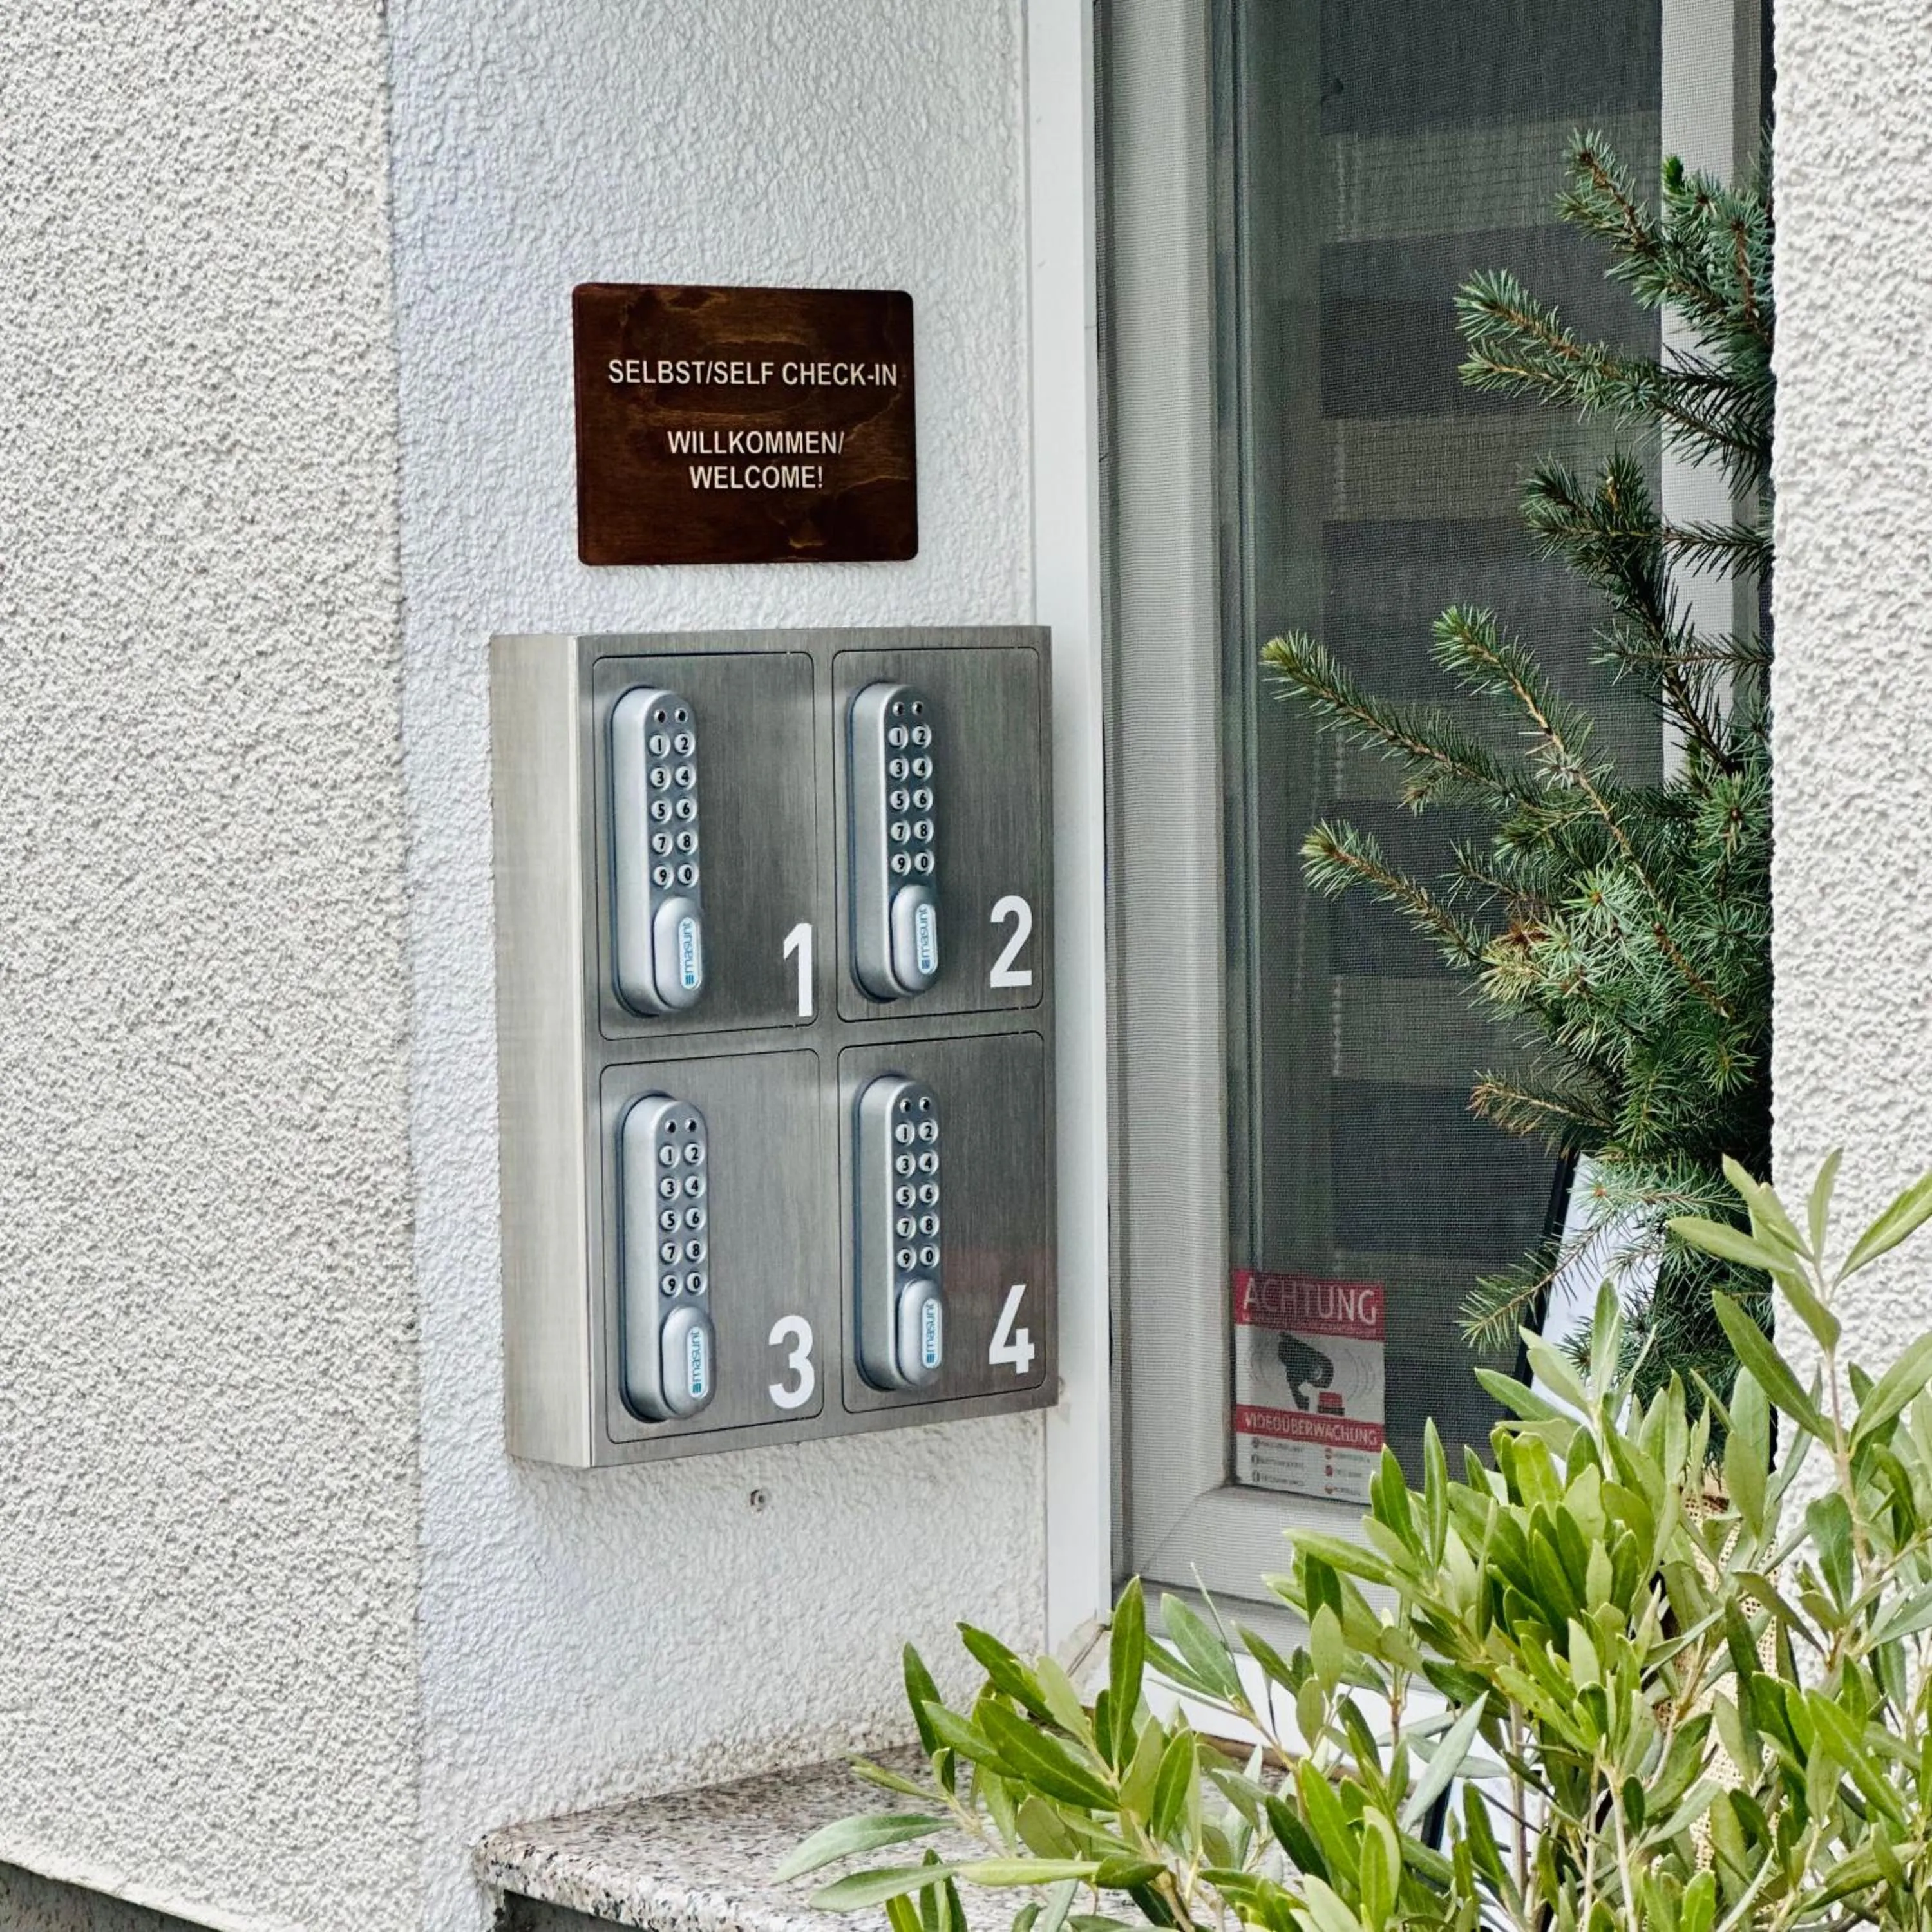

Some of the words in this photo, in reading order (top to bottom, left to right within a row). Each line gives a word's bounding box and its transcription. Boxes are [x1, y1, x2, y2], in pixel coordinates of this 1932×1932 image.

[608, 360, 775, 386] SELBST/SELF
[782, 361, 897, 386] CHECK-IN
[667, 431, 845, 455] WILLKOMMEN/
[690, 466, 823, 489] WELCOME!
[681, 737, 689, 750] 2
[918, 729, 926, 743] 2
[896, 762, 903, 775] 3
[918, 761, 926, 774] 4
[657, 770, 665, 784] 3
[681, 770, 690, 782] 4
[896, 793, 904, 807] 5
[919, 793, 927, 806] 6
[658, 803, 665, 817] 5
[682, 802, 690, 815] 6
[897, 825, 904, 838] 7
[920, 824, 928, 837] 8
[658, 836, 666, 849] 7
[683, 834, 691, 848] 8
[897, 857, 905, 870] 9
[920, 855, 929, 869] 0
[659, 869, 667, 883] 9
[684, 867, 692, 882] 0
[990, 895, 1032, 988] 2
[783, 923, 813, 1017] 1
[925, 1125, 933, 1138] 2
[691, 1147, 699, 1160] 2
[902, 1158, 909, 1171] 3
[924, 1156, 933, 1169] 4
[667, 1181, 675, 1195] 3
[691, 1179, 699, 1192] 4
[902, 1189, 910, 1202] 5
[925, 1187, 933, 1200] 6
[668, 1213, 676, 1227] 5
[692, 1211, 700, 1224] 6
[902, 1220, 910, 1234] 7
[925, 1218, 933, 1231] 8
[668, 1245, 676, 1259] 7
[692, 1243, 701, 1257] 8
[902, 1252, 911, 1265] 9
[925, 1249, 934, 1263] 0
[668, 1278, 676, 1291] 9
[692, 1276, 701, 1289] 0
[1244, 1277, 1377, 1325] ACHTUNG
[989, 1284, 1035, 1375] 4
[769, 1314, 815, 1410] 3
[1244, 1412, 1377, 1446] VIDEOÜBERWACHUNG
